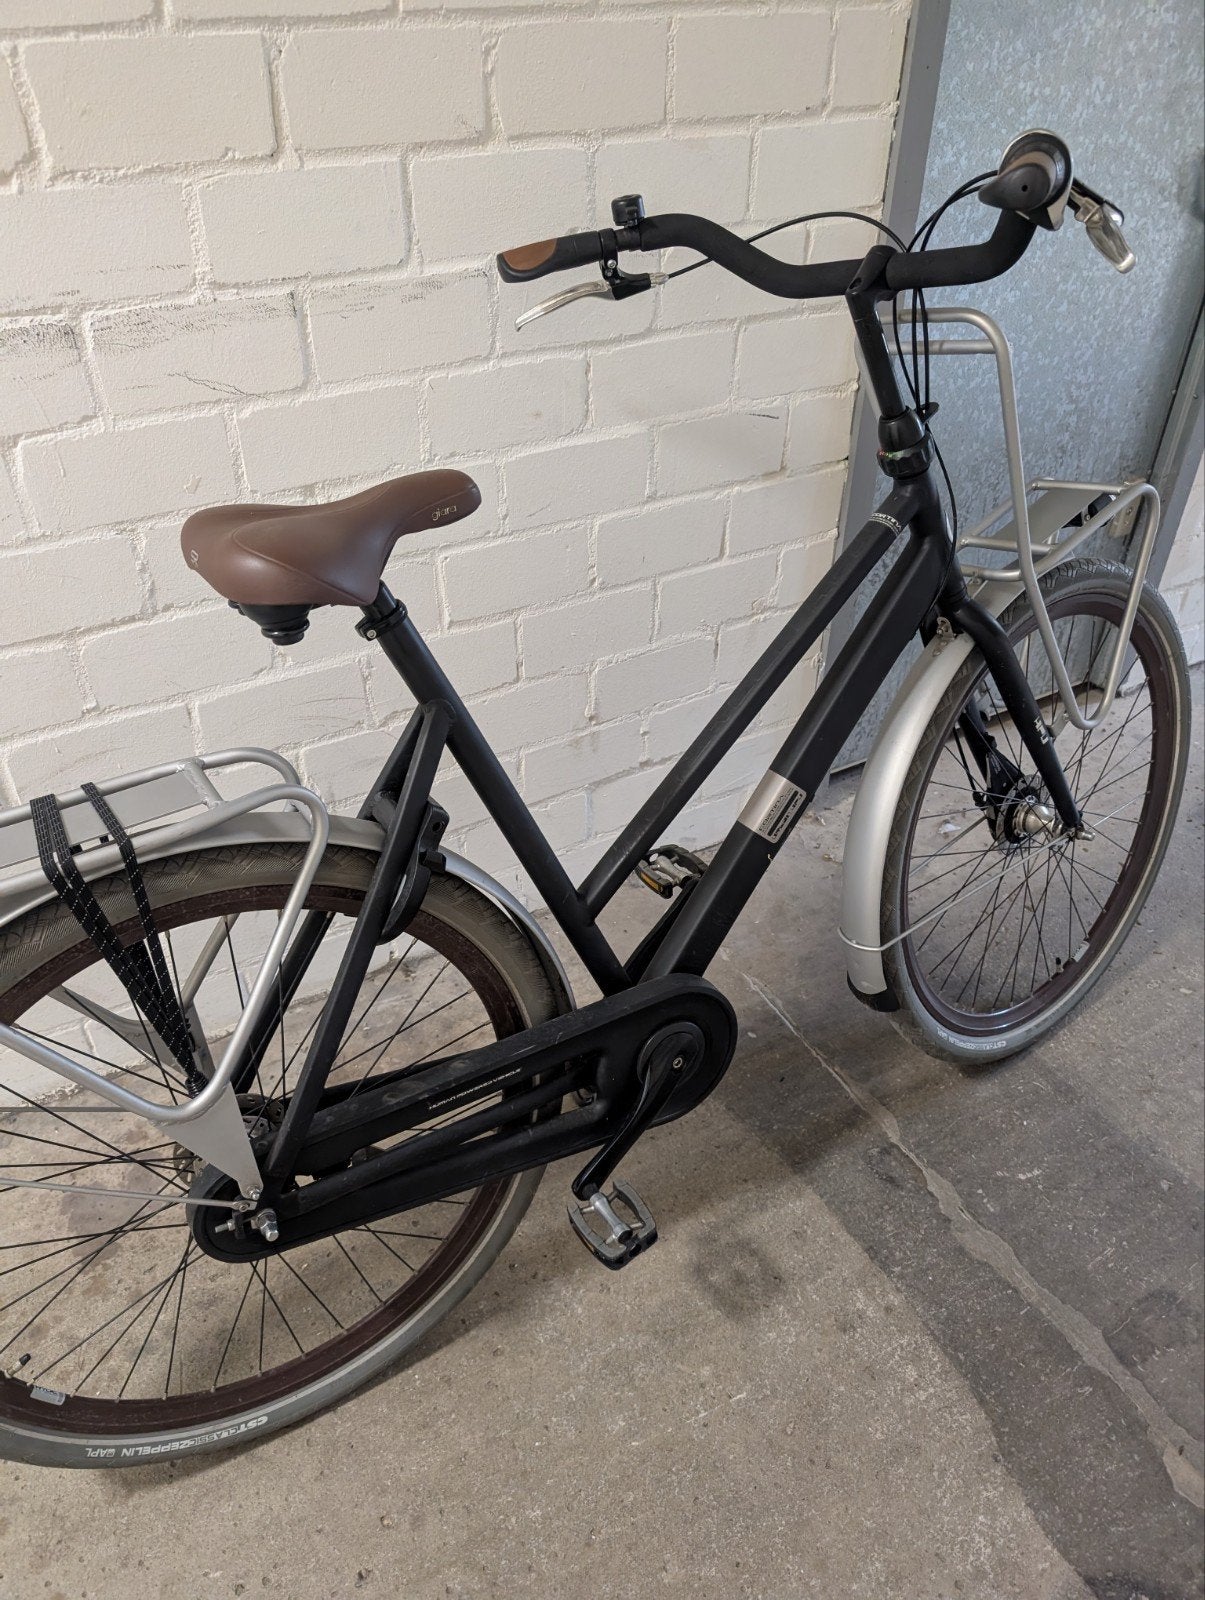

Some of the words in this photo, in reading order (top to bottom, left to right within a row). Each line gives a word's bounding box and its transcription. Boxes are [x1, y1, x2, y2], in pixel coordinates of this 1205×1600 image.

[432, 505, 457, 521] giara
[429, 1095, 456, 1110] HUMAN
[237, 1415, 268, 1435] CST
[121, 1440, 190, 1457] ZEPPELIN
